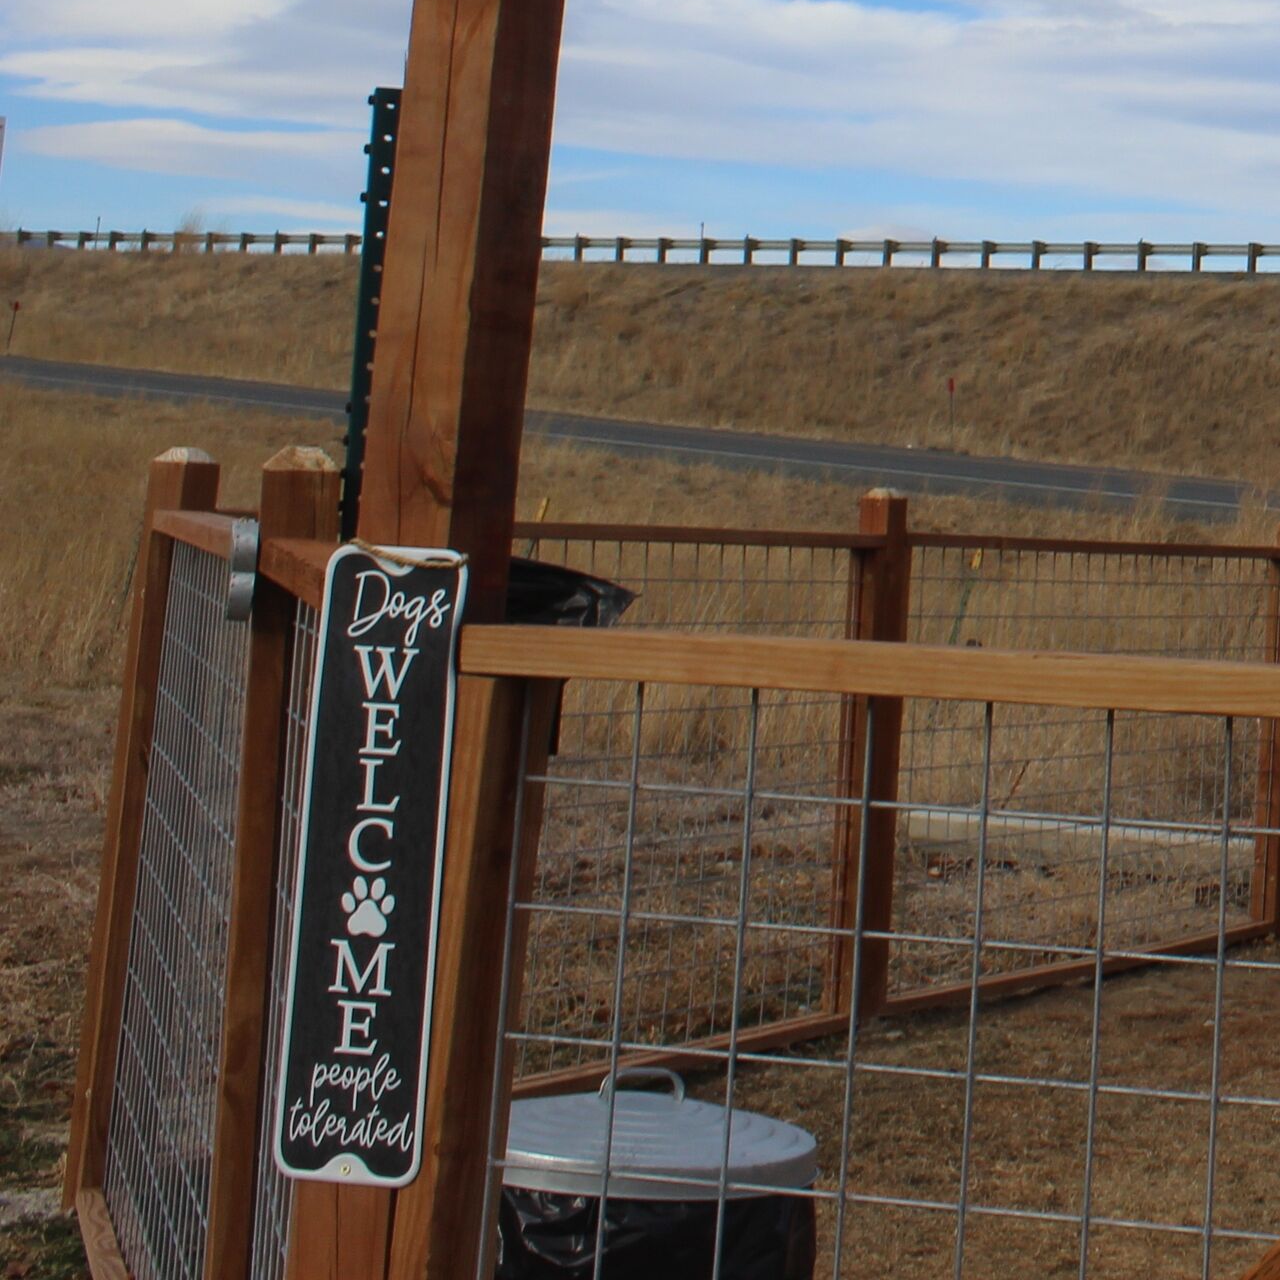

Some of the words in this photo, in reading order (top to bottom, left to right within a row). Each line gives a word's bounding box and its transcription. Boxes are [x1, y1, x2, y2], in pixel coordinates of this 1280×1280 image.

[347, 570, 451, 646] Dogs
[309, 1053, 401, 1111] people
[289, 1097, 414, 1152] tolerated
